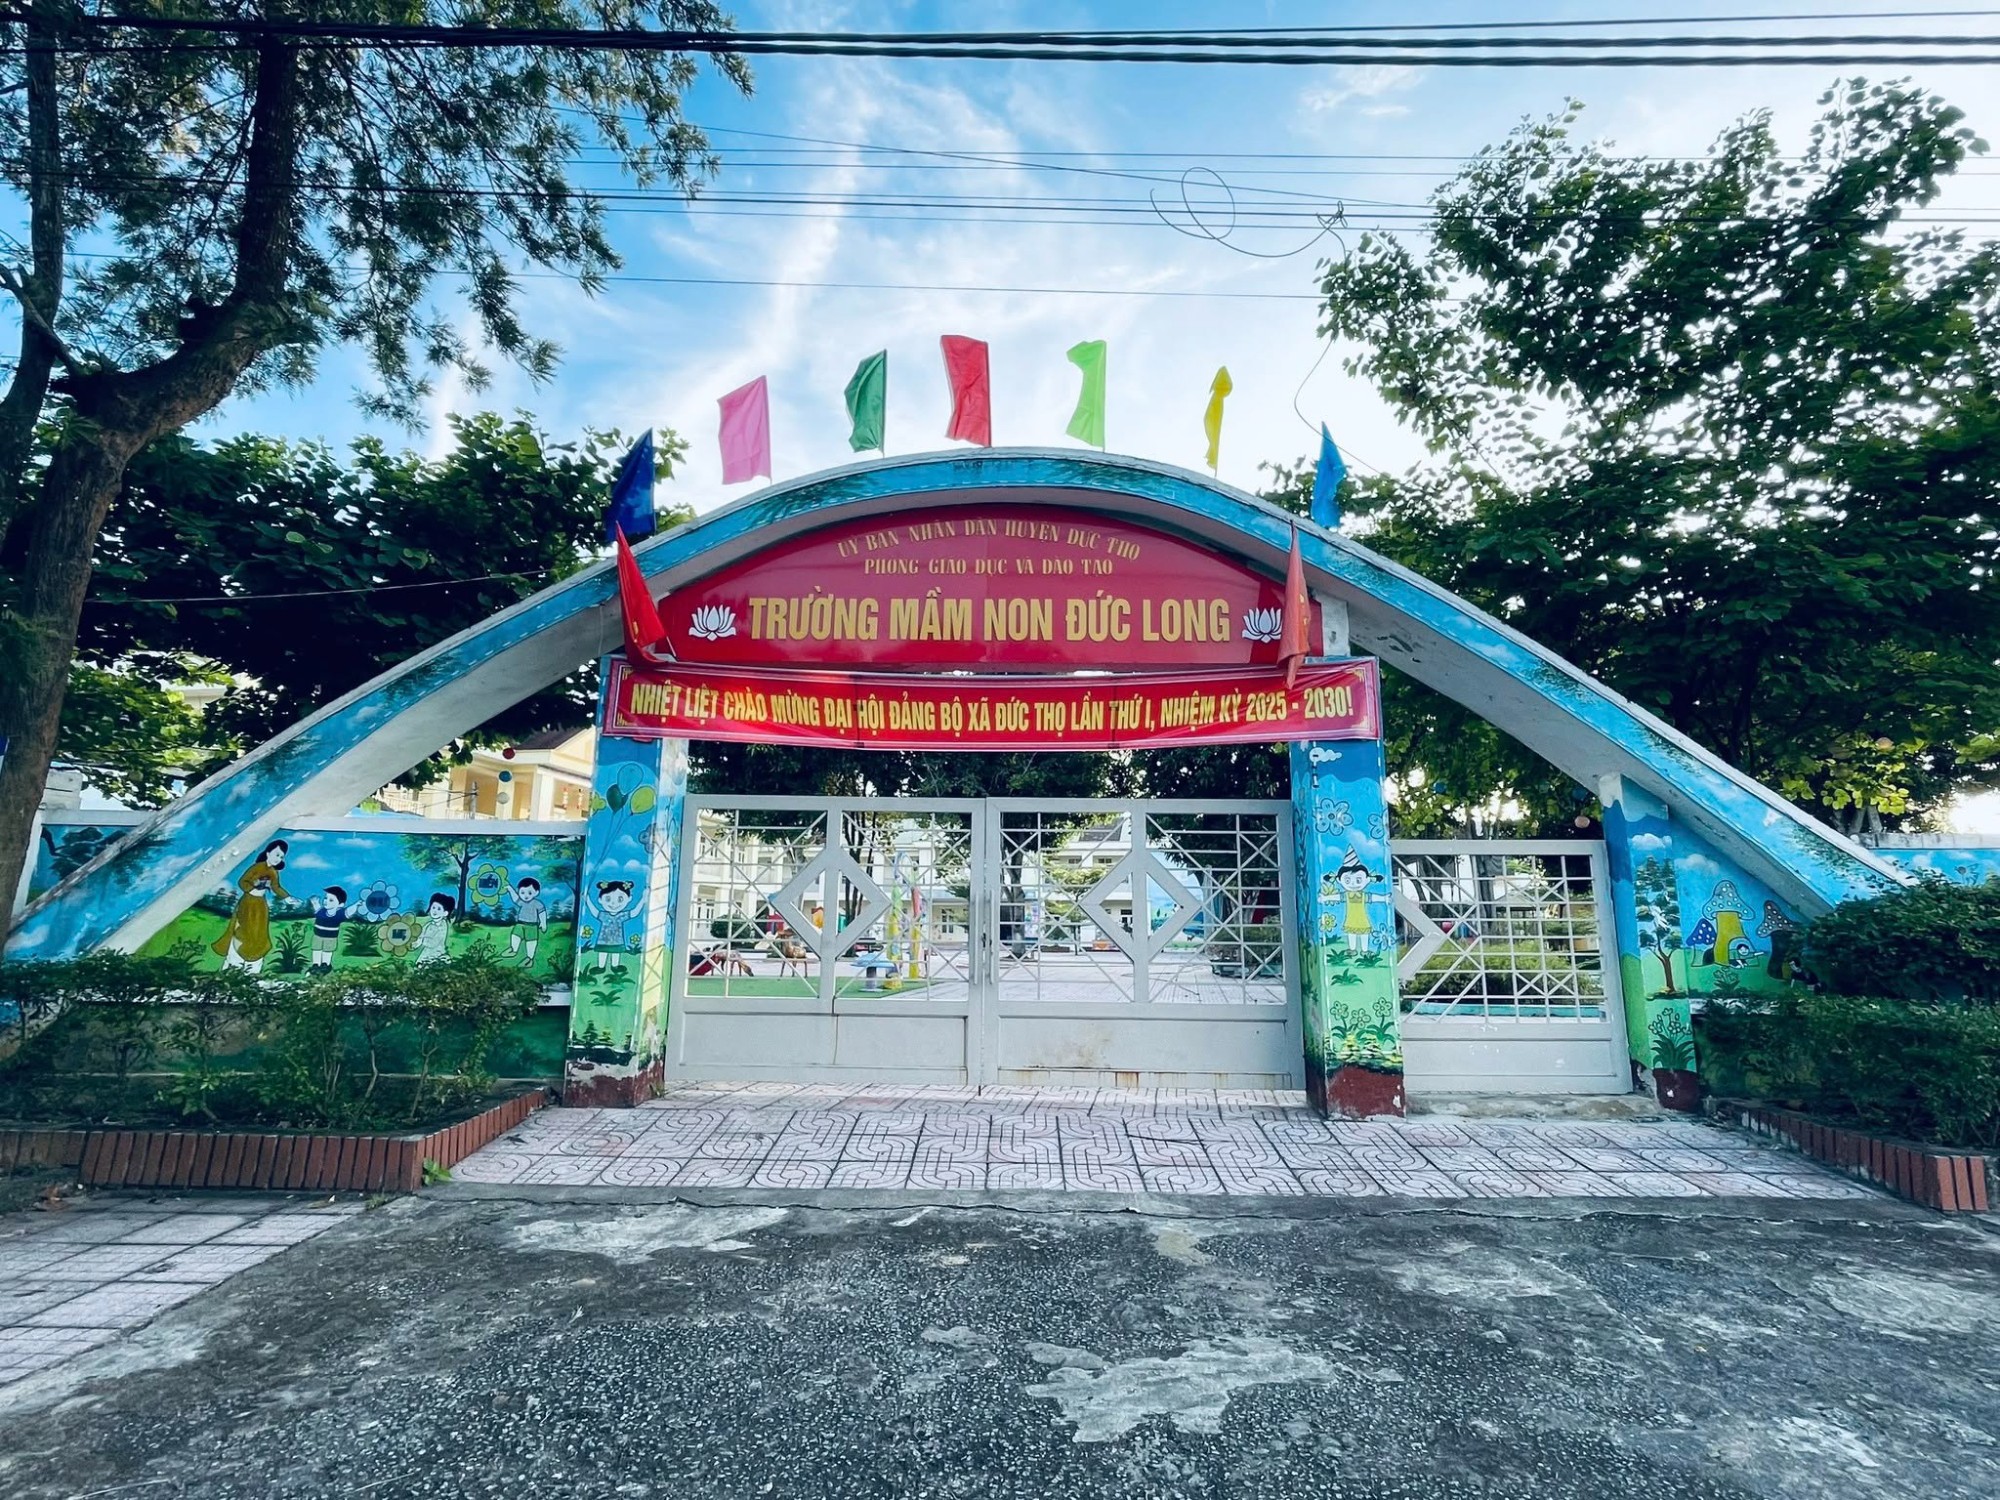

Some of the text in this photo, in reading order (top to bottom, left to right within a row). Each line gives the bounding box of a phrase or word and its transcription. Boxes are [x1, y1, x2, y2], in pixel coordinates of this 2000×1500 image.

[865, 530, 900, 551] BAN
[749, 585, 1231, 642] TRƯỜNG MẦM NON ĐỨC LONG
[631, 679, 682, 724] NHIỆT
[684, 682, 719, 725] LIỆT
[723, 686, 768, 722] CHÀO
[771, 689, 821, 727] MỪNG
[824, 698, 853, 735] ĐẠI
[857, 693, 885, 736] HỘI
[889, 691, 936, 731] ĐẢNG
[940, 695, 963, 737] BỘ
[968, 696, 991, 731] XÃ
[995, 696, 1029, 732] ĐỨC
[1034, 701, 1066, 737] THỌ
[1071, 691, 1104, 731] LẦN
[1108, 693, 1144, 730] THỨ
[1160, 690, 1216, 731] NHIỆM
[1219, 687, 1242, 723] KỲ
[1246, 691, 1287, 721] 2025
[1304, 685, 1354, 719] 2030!
